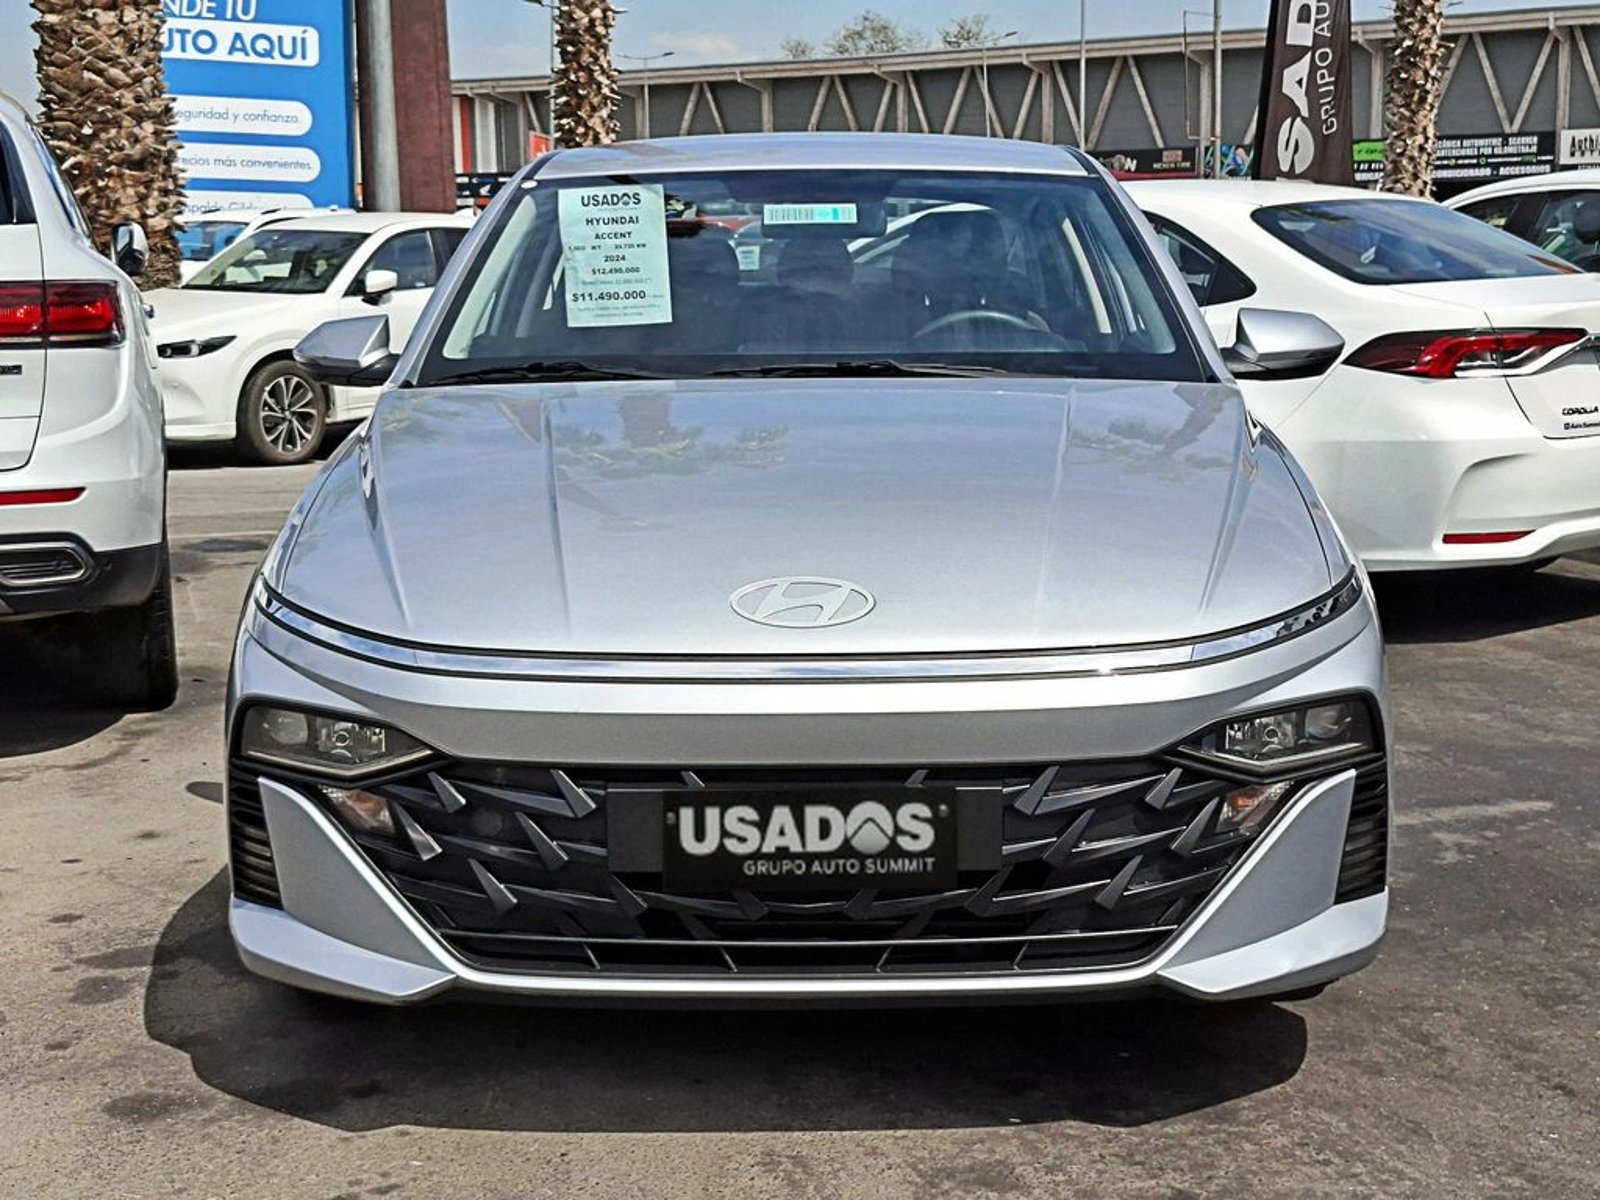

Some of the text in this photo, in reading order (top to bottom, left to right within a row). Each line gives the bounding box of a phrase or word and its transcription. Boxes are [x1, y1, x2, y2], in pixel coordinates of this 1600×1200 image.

[227, 29, 308, 60] AQUÍ
[1314, 48, 1338, 135] GRUPO
[232, 112, 240, 124] y
[214, 154, 237, 167] más
[580, 192, 641, 207] USADOS
[585, 216, 639, 226] HYUNDAI
[594, 231, 632, 240] ACCENT
[603, 254, 626, 263] 2024
[572, 290, 647, 302] $11.490.000
[679, 801, 936, 855] USADOS
[743, 857, 936, 875] GRUPO AUTO SUMMIT
